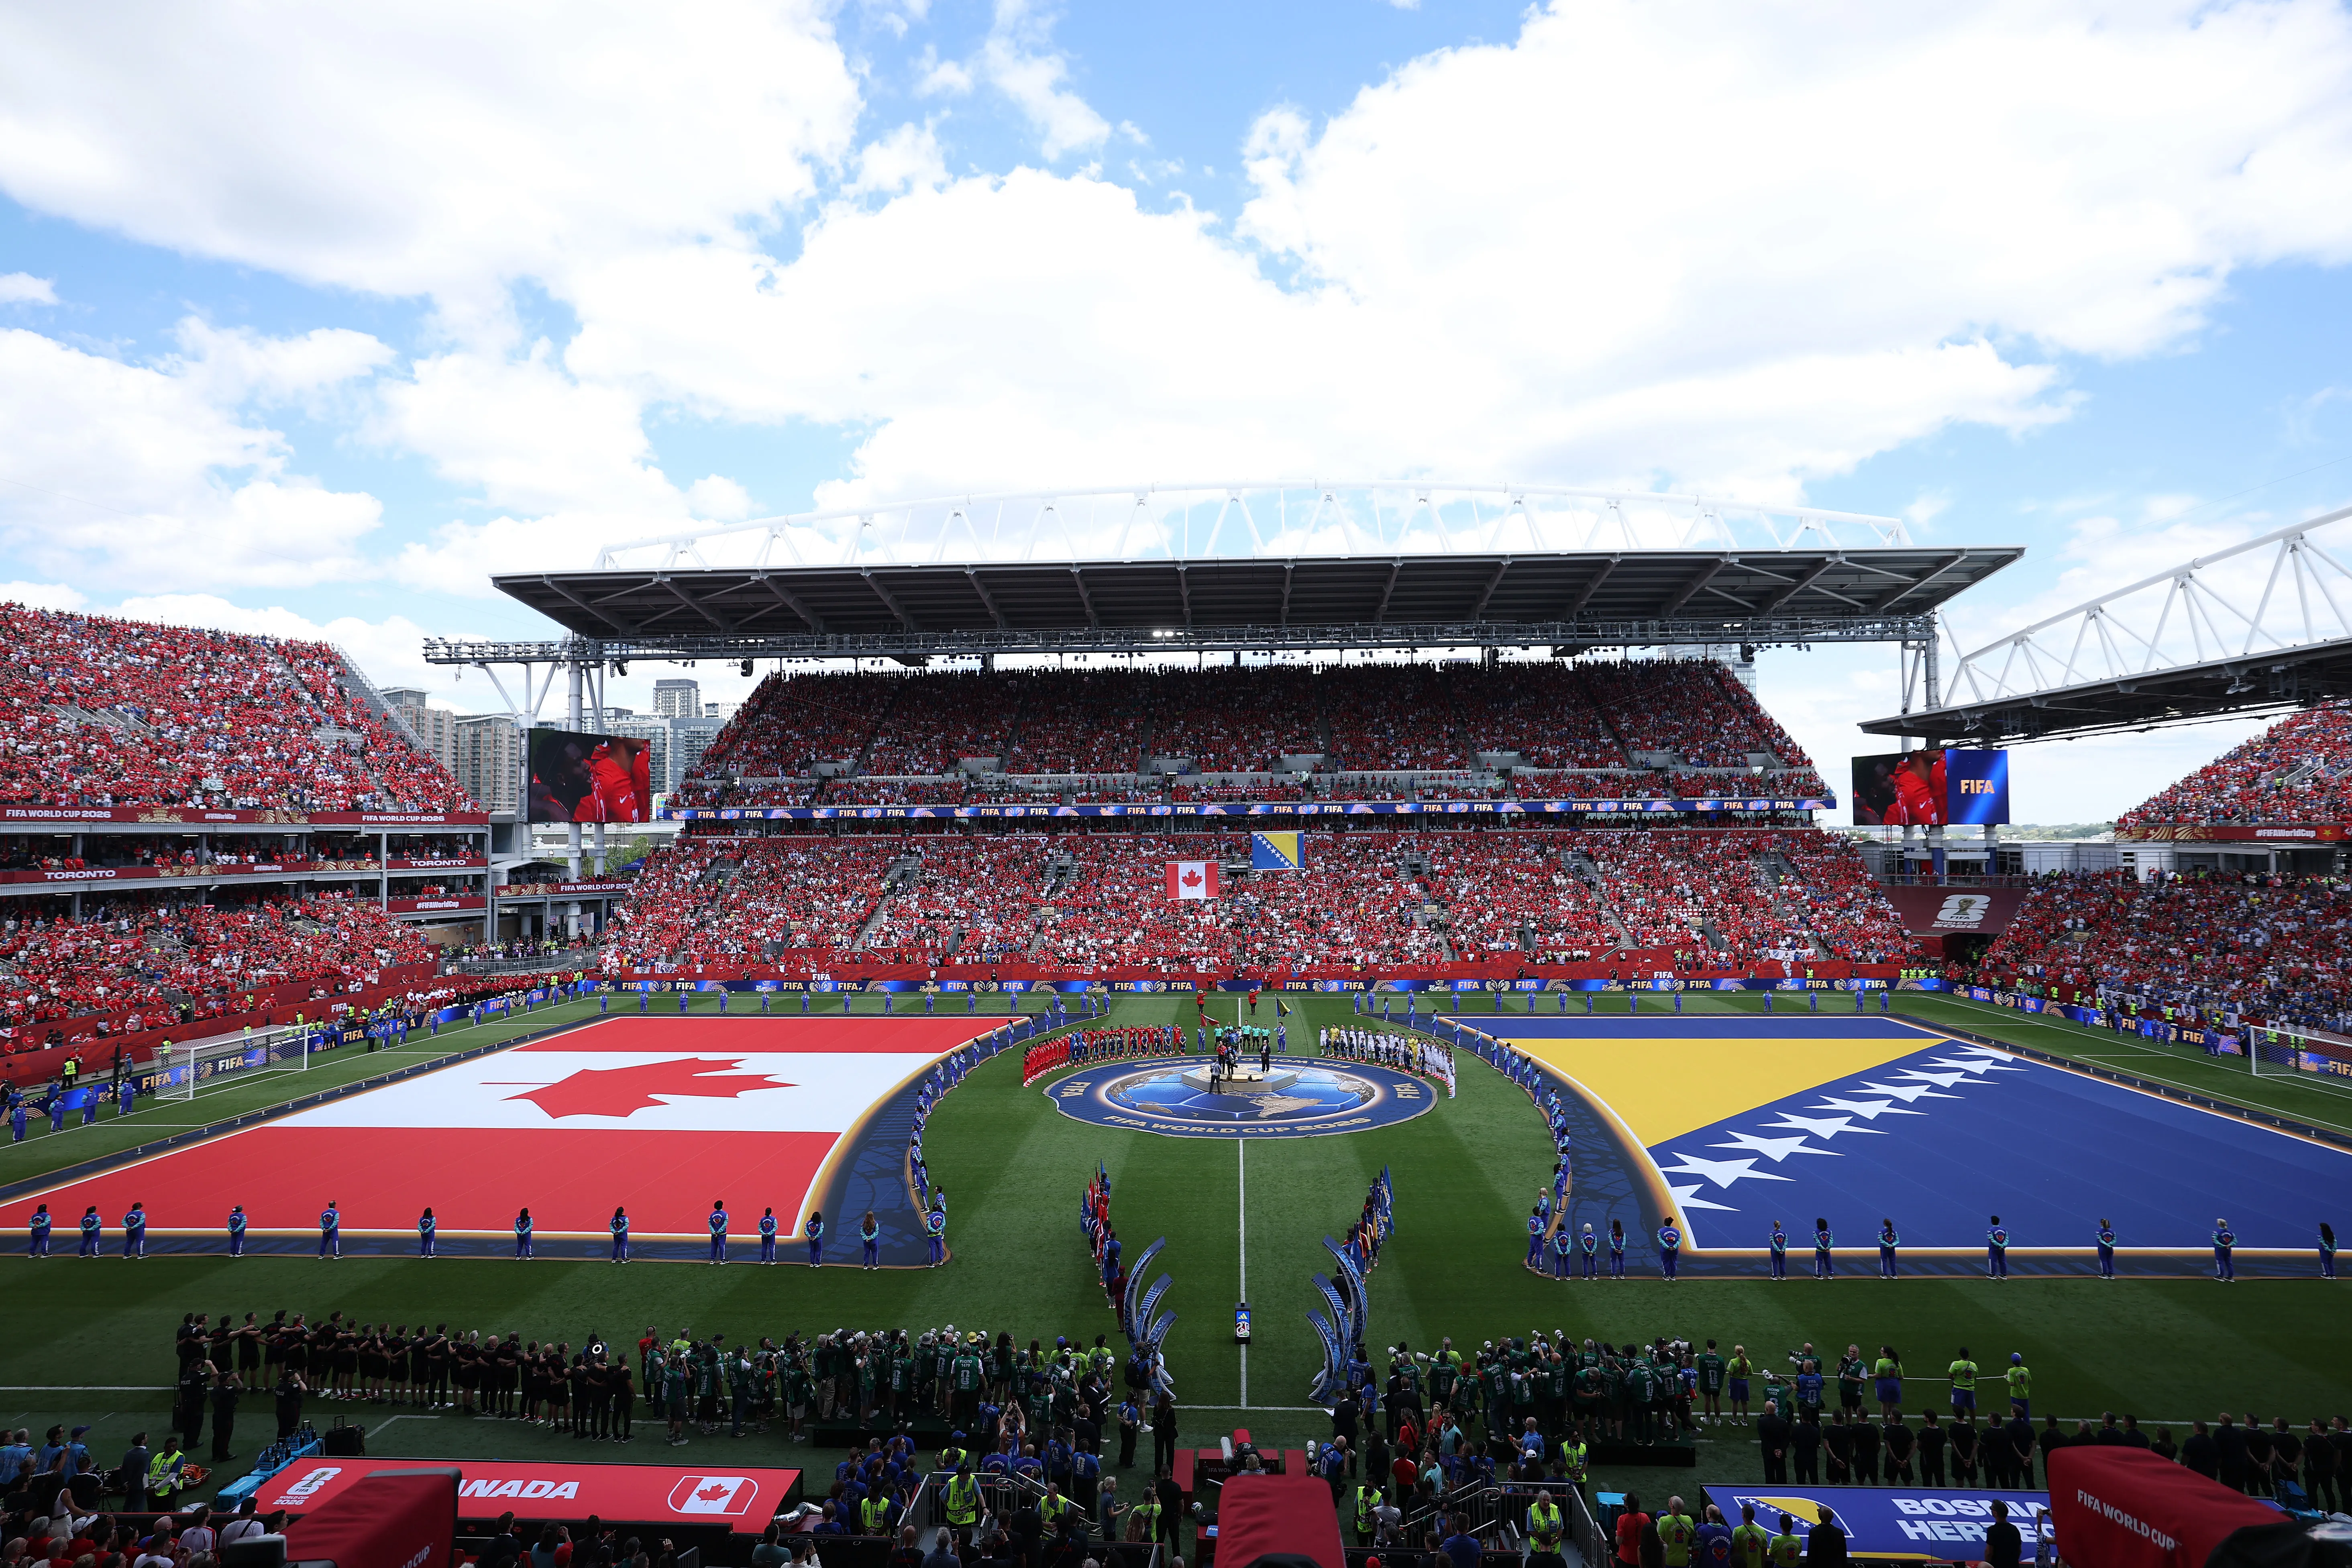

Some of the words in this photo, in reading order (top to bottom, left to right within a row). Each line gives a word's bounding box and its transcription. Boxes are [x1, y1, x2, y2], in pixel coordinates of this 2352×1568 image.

[1960, 779, 1995, 794] FIFA
[6, 809, 27, 817] FIFA
[28, 809, 62, 818] WORLD
[2255, 828, 2316, 838] #FIFAWorldCup
[44, 870, 116, 879] TORONTO
[416, 901, 459, 909] #FIFAWorldCup
[1973, 989, 1990, 1000] FIFA
[331, 1003, 348, 1013] FIFA
[343, 1029, 364, 1042] FIFA
[218, 1056, 244, 1071] FIFA
[142, 1073, 171, 1089] FIFA
[1061, 1081, 1092, 1097] FIFA
[1392, 1083, 1420, 1099] FIFA
[1103, 1115, 1147, 1127] FIFA
[1152, 1123, 1237, 1133] WORLD
[1294, 1117, 1372, 1131] 2026
[987, 1460, 1005, 1468] VOLUNTEER
[458, 1479, 580, 1499] NADA
[2077, 1488, 2101, 1514] FIFA
[2103, 1502, 2150, 1537] WORLD
[1708, 1535, 1731, 1546] VOLUNTEER
